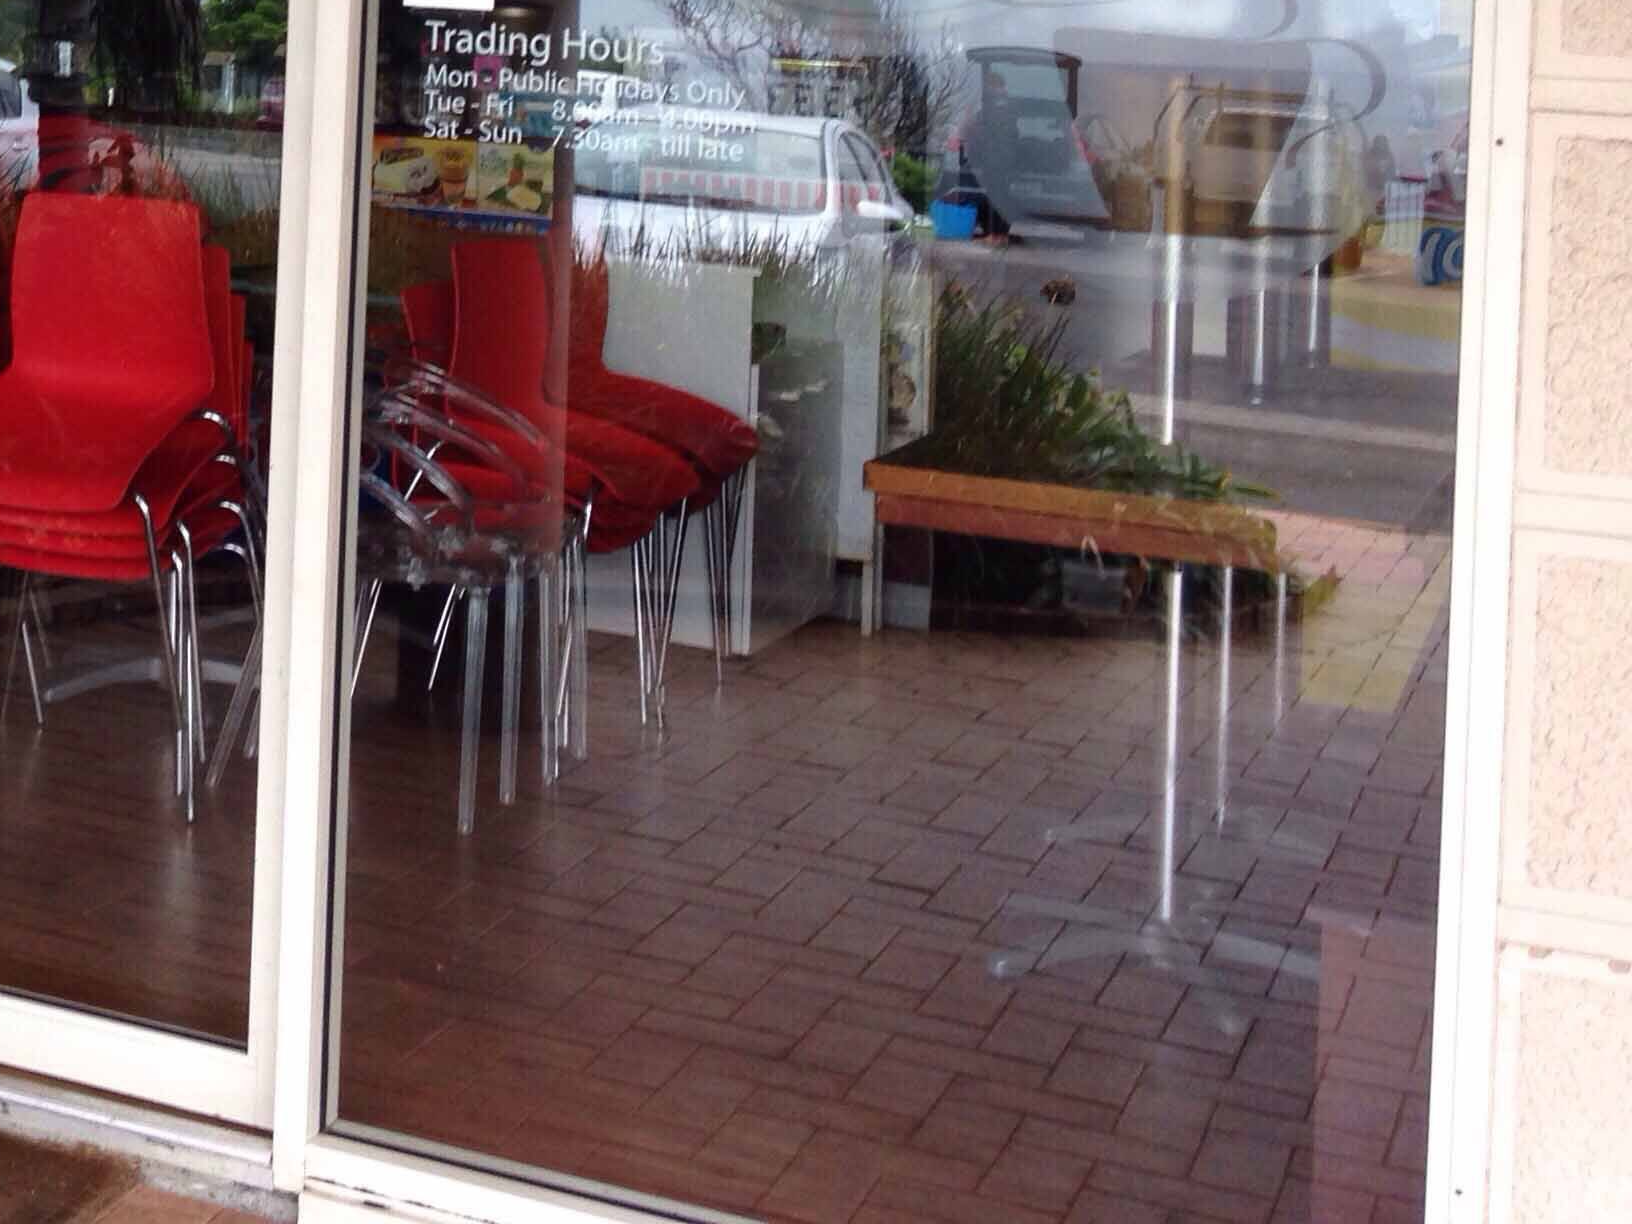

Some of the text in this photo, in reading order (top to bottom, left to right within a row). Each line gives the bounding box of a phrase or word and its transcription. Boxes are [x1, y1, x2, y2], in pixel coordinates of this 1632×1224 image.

[425, 20, 665, 67] Trading Hours
[424, 90, 465, 116] Tue
[486, 93, 514, 116] Fri
[425, 64, 477, 89] Mon
[498, 67, 568, 94] Public
[576, 75, 679, 108] Holidays
[686, 82, 746, 112] Only
[423, 116, 458, 139] Sat
[477, 120, 522, 145] Sun
[661, 133, 689, 157] till
[698, 136, 745, 161] late
